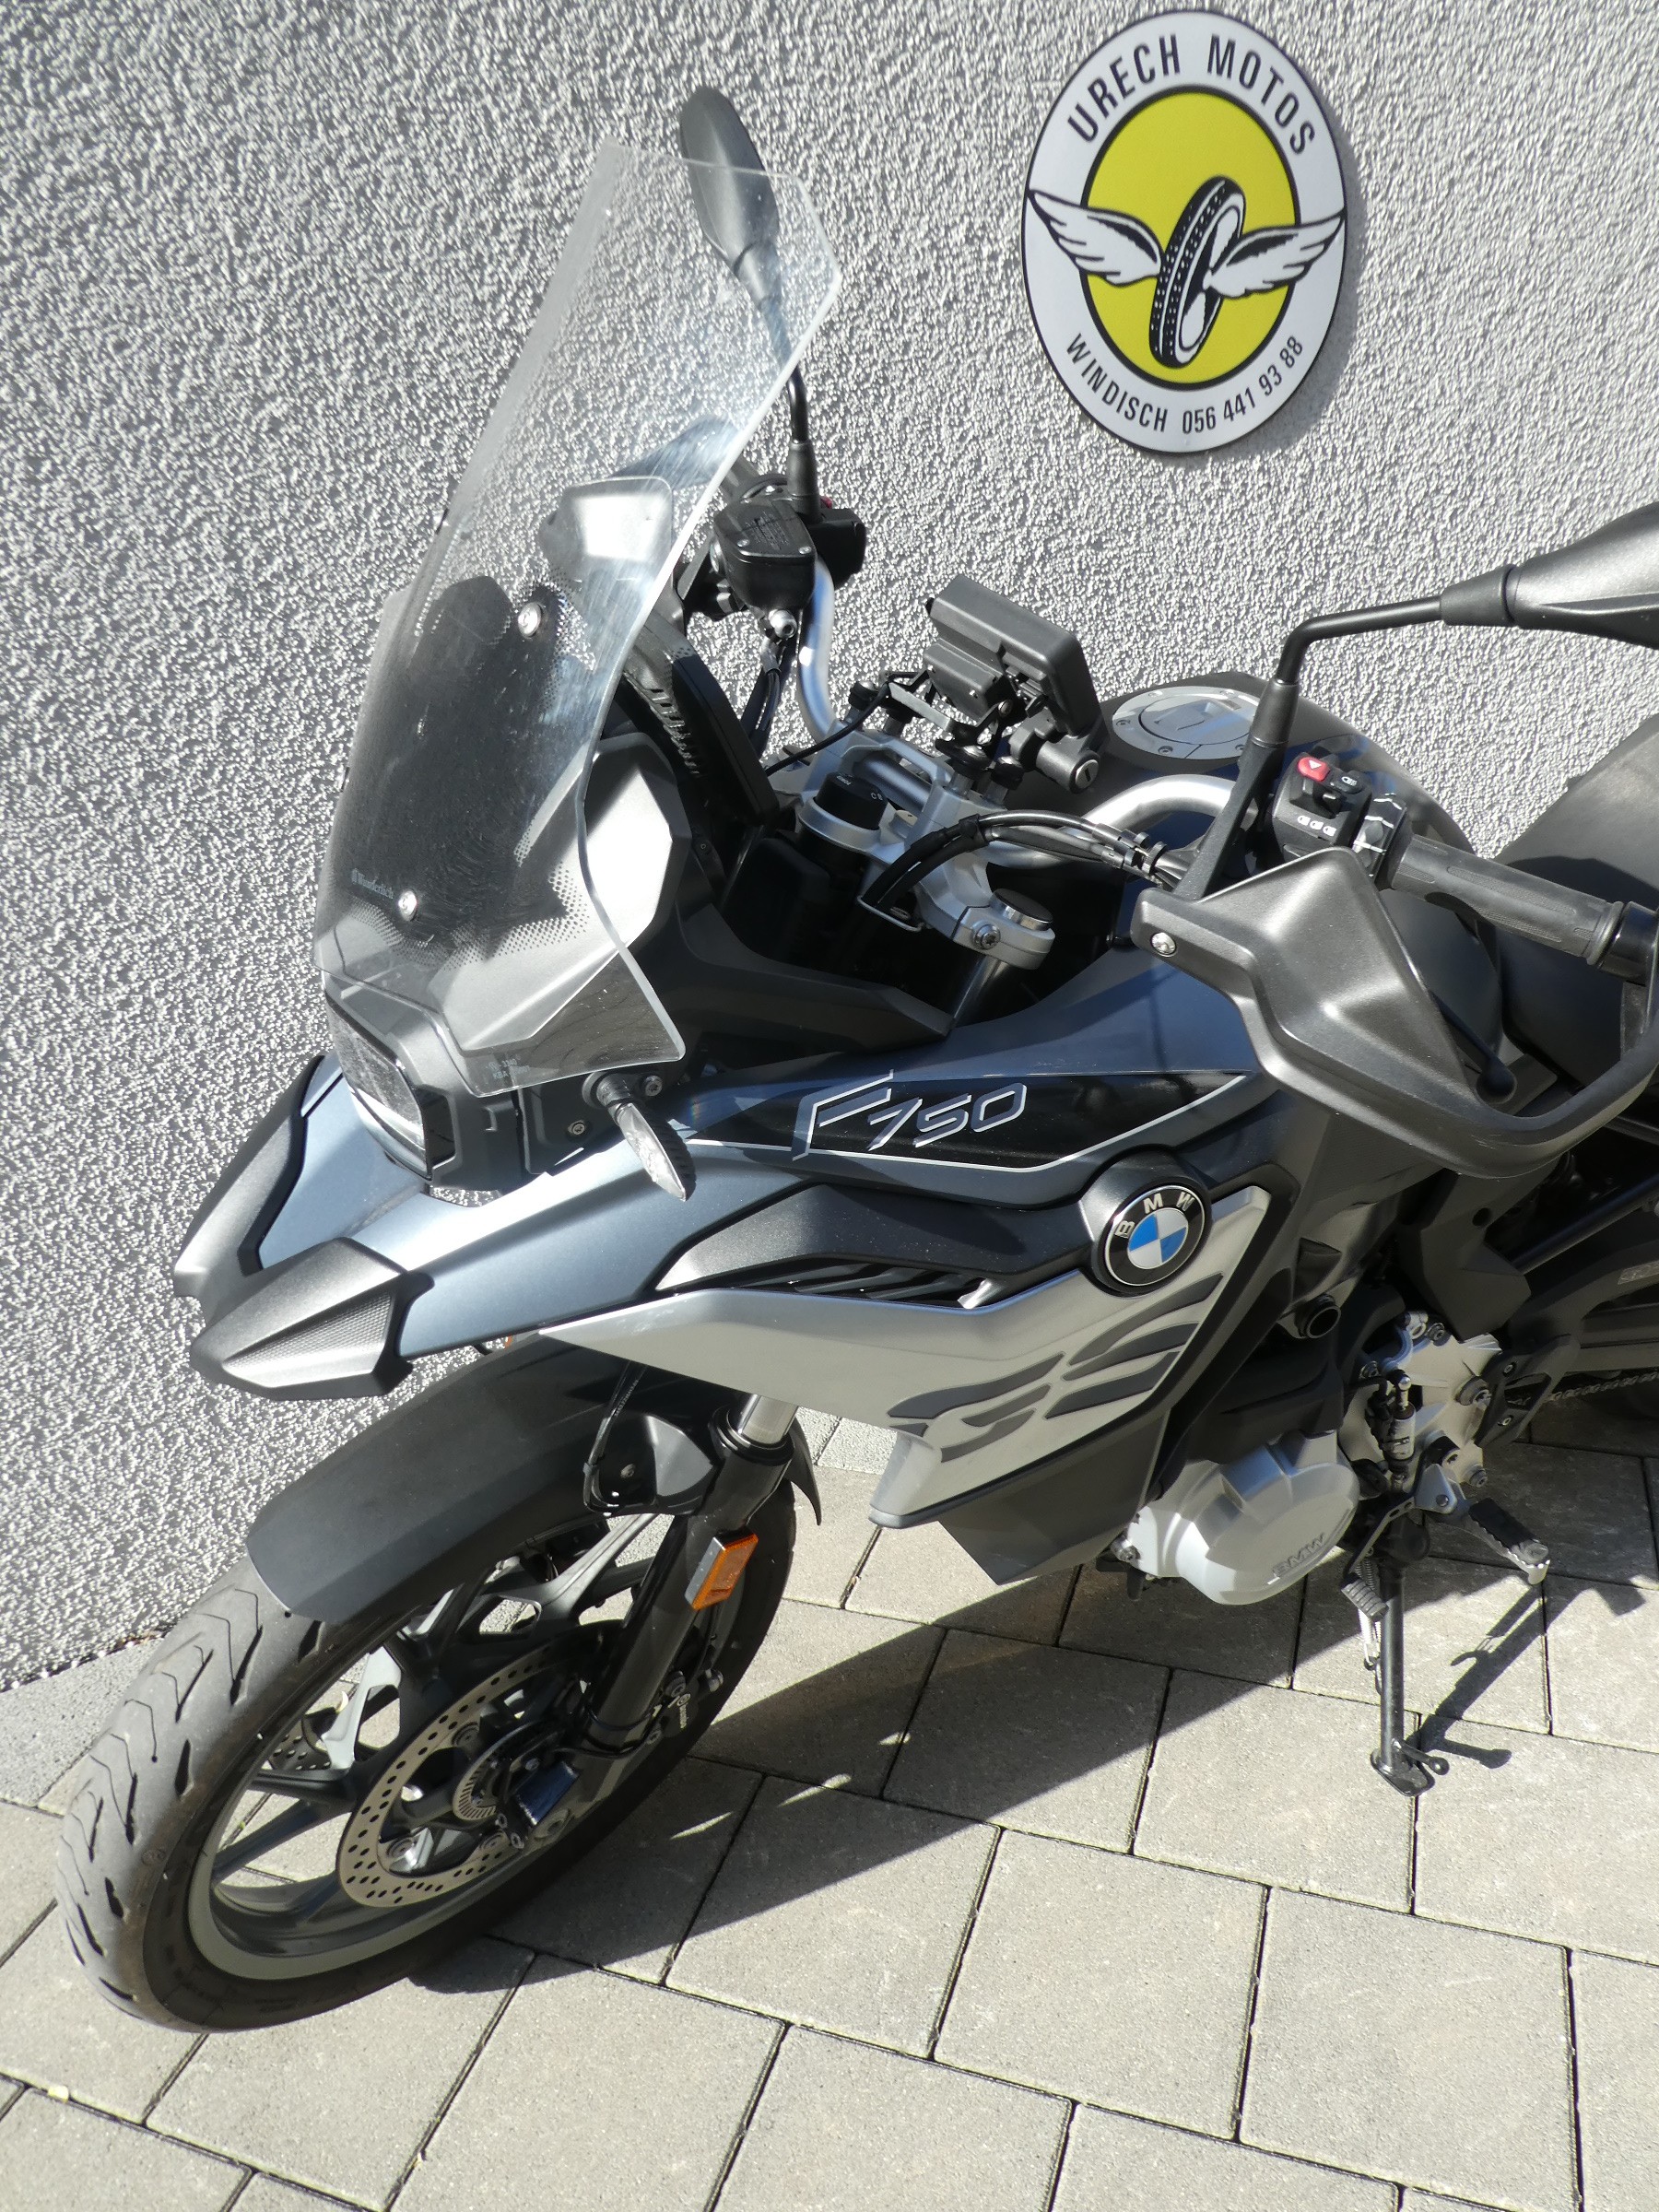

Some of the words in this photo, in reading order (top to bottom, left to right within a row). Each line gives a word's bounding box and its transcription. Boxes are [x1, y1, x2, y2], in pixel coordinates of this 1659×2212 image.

[1067, 34, 1181, 143] URECH
[1207, 34, 1316, 155] MOTOS
[1066, 333, 1169, 433] WINDISCH
[1182, 406, 1217, 435] 056
[1223, 386, 1256, 421] 441
[1258, 364, 1283, 396] 93
[1279, 335, 1303, 369] 88
[1114, 1190, 1195, 1240] BMW
